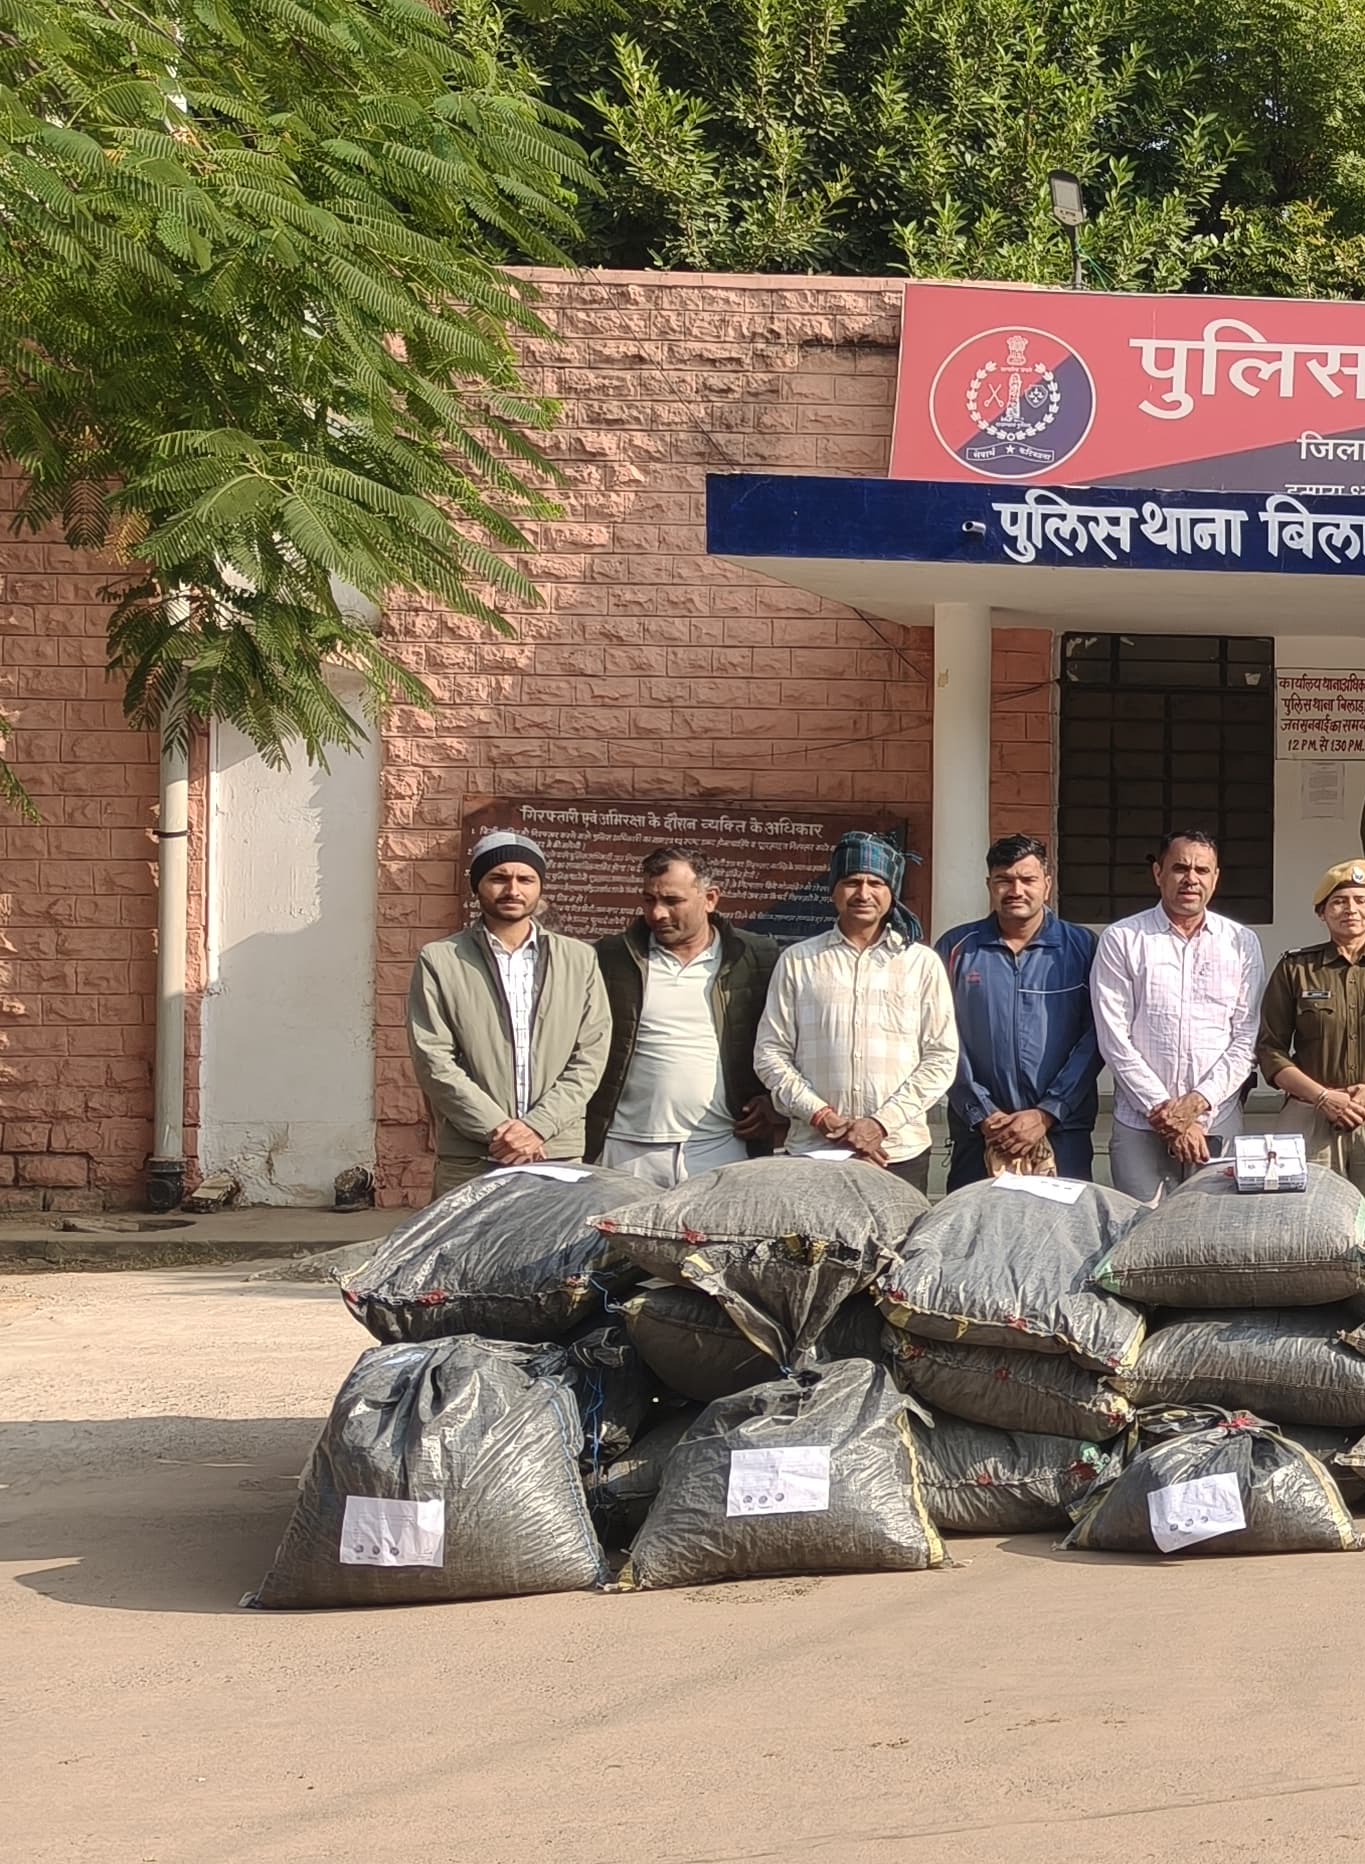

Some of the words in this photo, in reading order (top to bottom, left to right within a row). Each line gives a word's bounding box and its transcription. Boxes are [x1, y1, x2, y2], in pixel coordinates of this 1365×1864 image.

[991, 488, 1138, 564] पुलिस
[1140, 501, 1249, 558] थाना
[1278, 673, 1321, 691] कार्यालय
[1281, 691, 1312, 716] पुलिस
[1312, 697, 1335, 713] थाना
[1288, 739, 1300, 751] 12
[1319, 735, 1330, 752] से
[519, 804, 579, 825] गिरफ्तारी
[581, 809, 597, 828] एवं
[598, 808, 645, 829] अभिरक्षा
[647, 811, 661, 829] के
[700, 814, 747, 833] व्यक्ति
[748, 816, 763, 834] के
[764, 816, 824, 839] अधिकार
